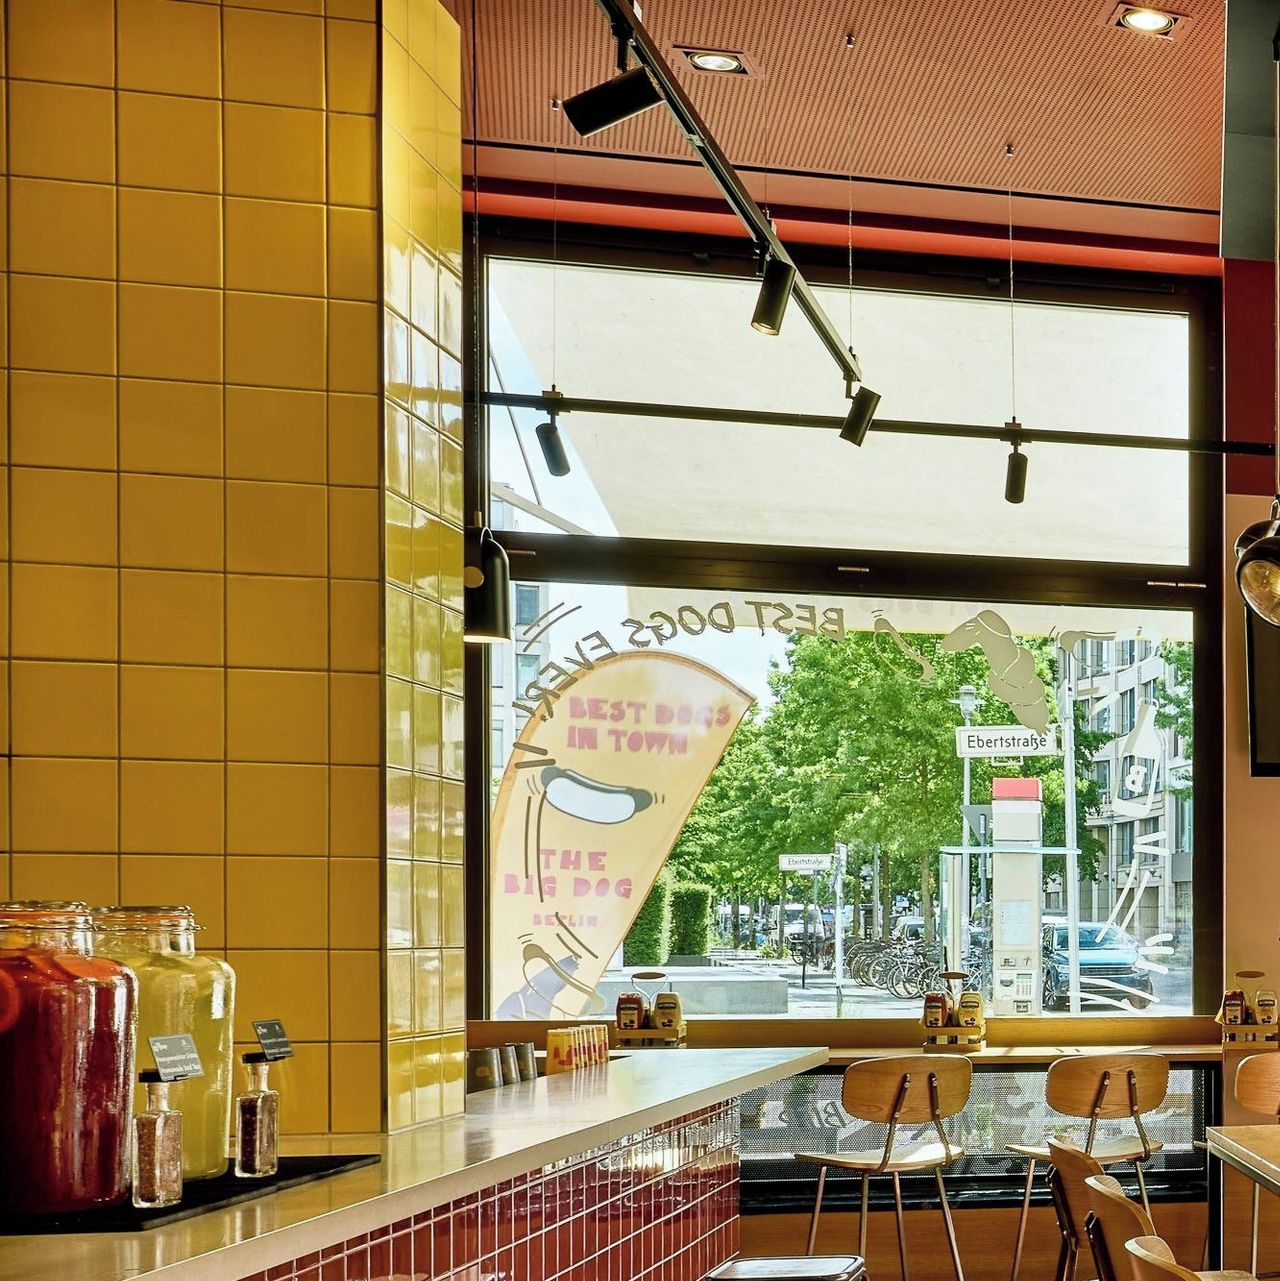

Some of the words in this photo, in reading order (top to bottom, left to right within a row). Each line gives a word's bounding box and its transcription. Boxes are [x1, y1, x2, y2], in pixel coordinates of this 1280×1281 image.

[570, 696, 647, 724] BEST
[655, 701, 732, 729] DOGS
[566, 725, 598, 750] IN
[607, 728, 689, 756] TOWN
[967, 733, 1047, 751] Ebertstraße
[540, 848, 607, 872] THE
[504, 873, 557, 898] BIG
[573, 877, 633, 899] DOG
[532, 913, 598, 928] BERLIN
